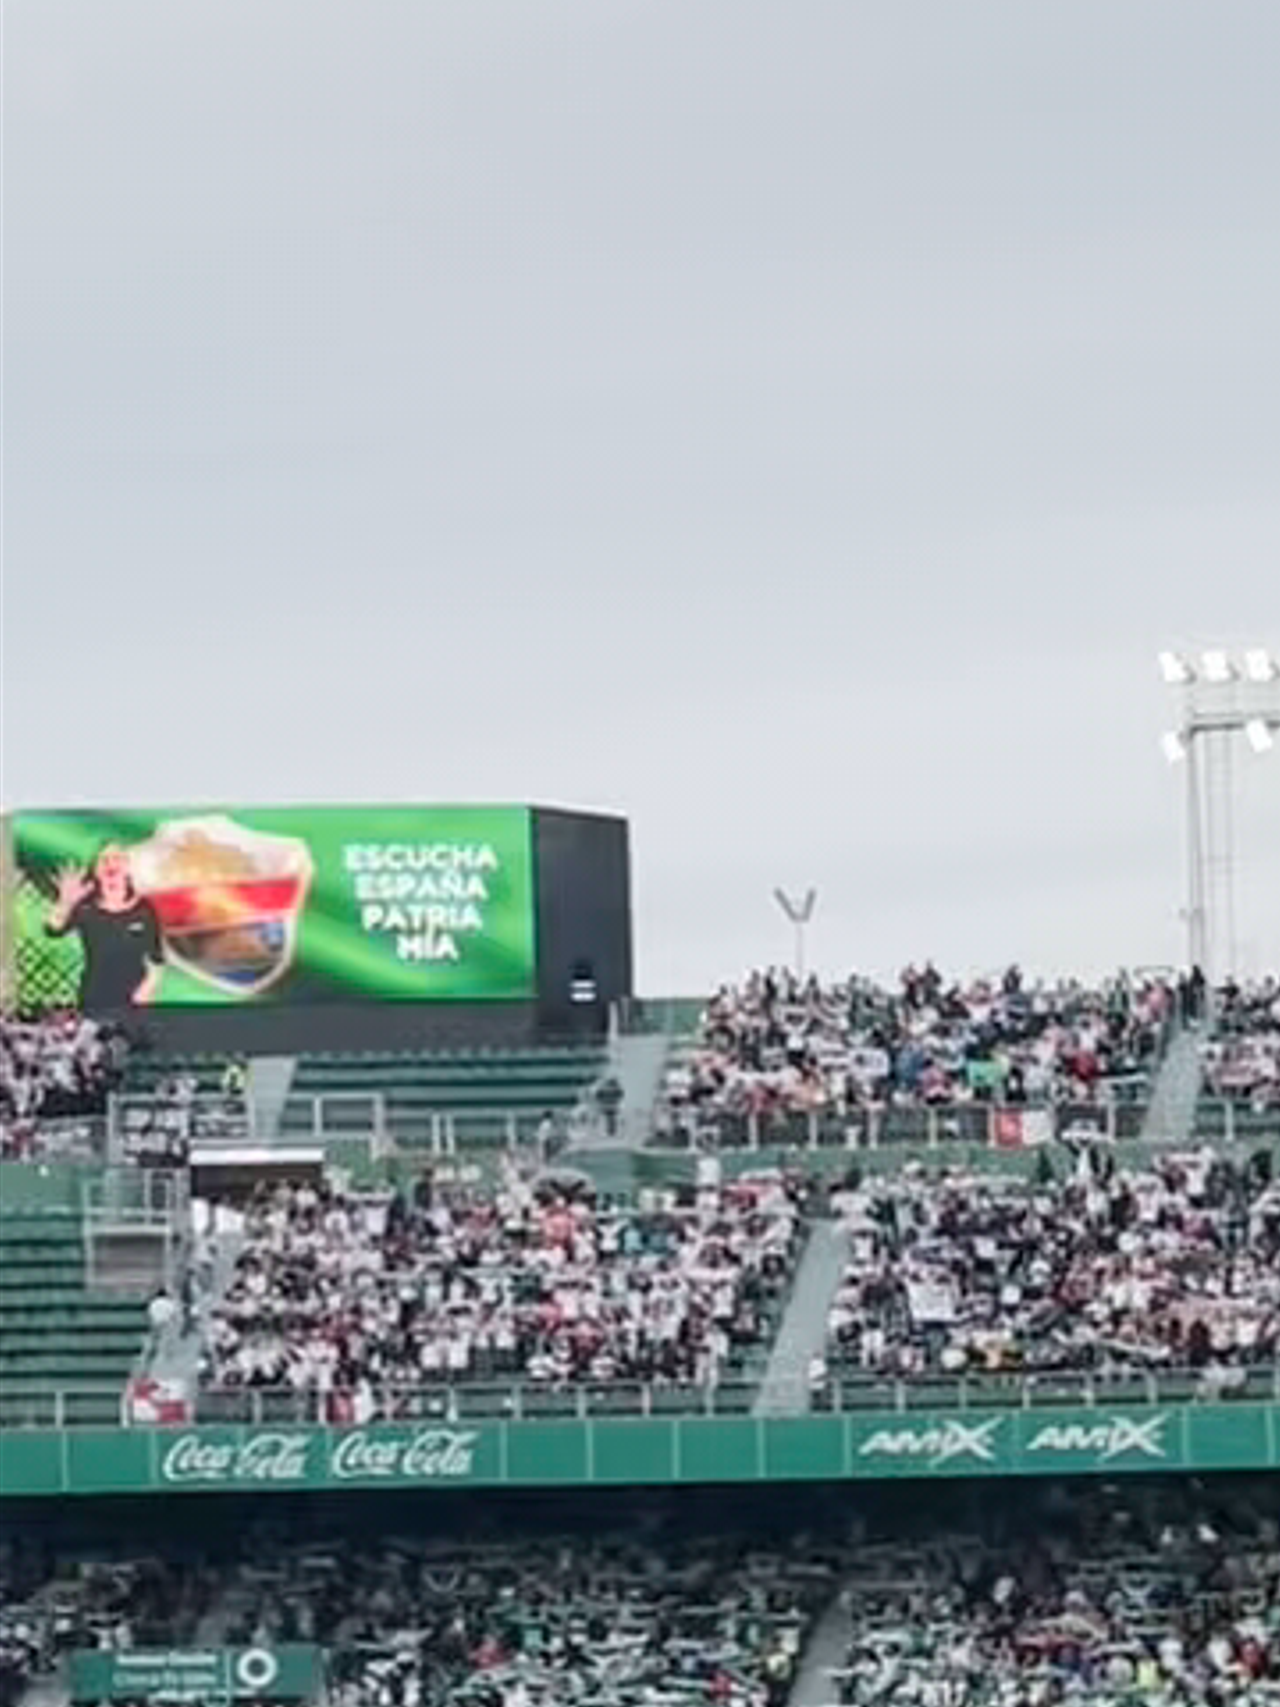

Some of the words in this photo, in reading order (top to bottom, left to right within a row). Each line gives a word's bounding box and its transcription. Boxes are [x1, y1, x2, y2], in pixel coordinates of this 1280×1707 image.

[343, 843, 498, 871] ESCUCHA
[355, 869, 490, 900] ESPAÑA
[361, 902, 484, 931] PATRIA
[396, 926, 460, 960] MÍA
